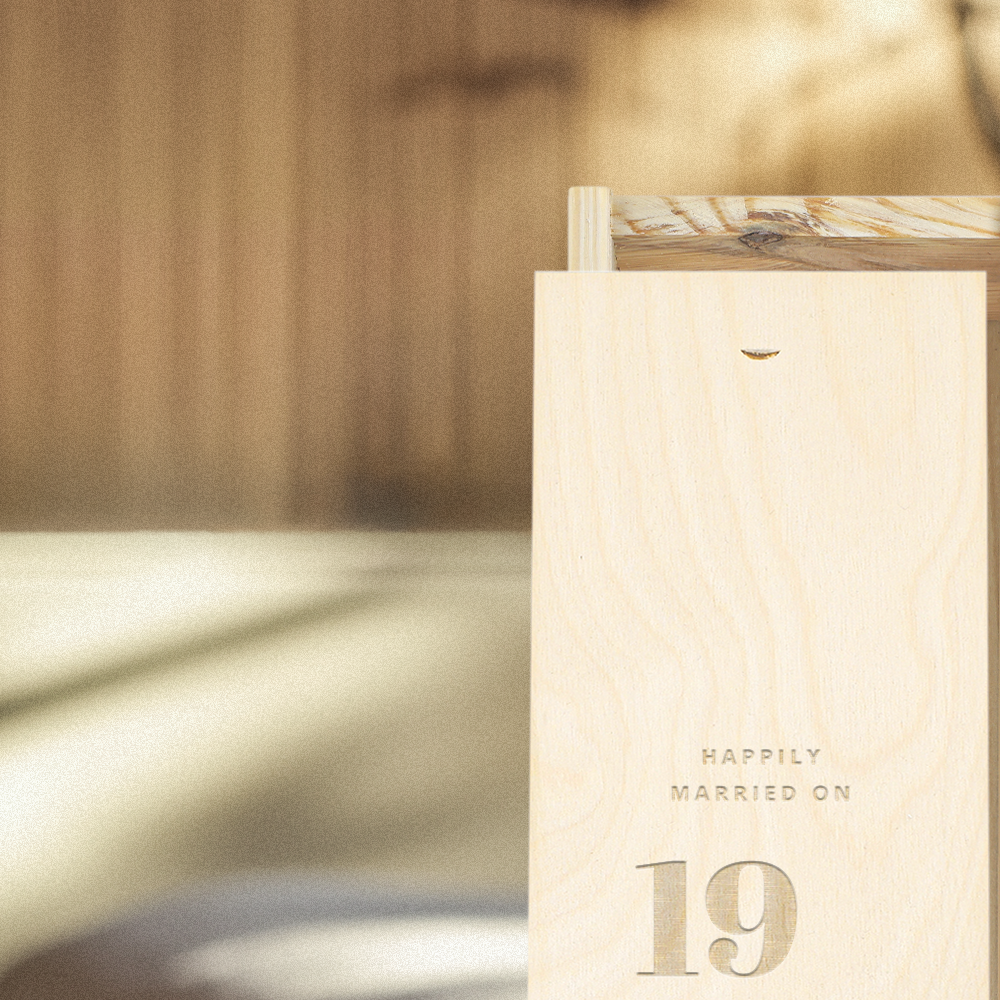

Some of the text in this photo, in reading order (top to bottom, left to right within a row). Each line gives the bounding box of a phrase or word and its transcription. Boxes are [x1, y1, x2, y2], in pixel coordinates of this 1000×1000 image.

[702, 749, 821, 765] HAPPILY
[671, 785, 851, 801] MARRIED ON
[636, 860, 797, 978] 19
